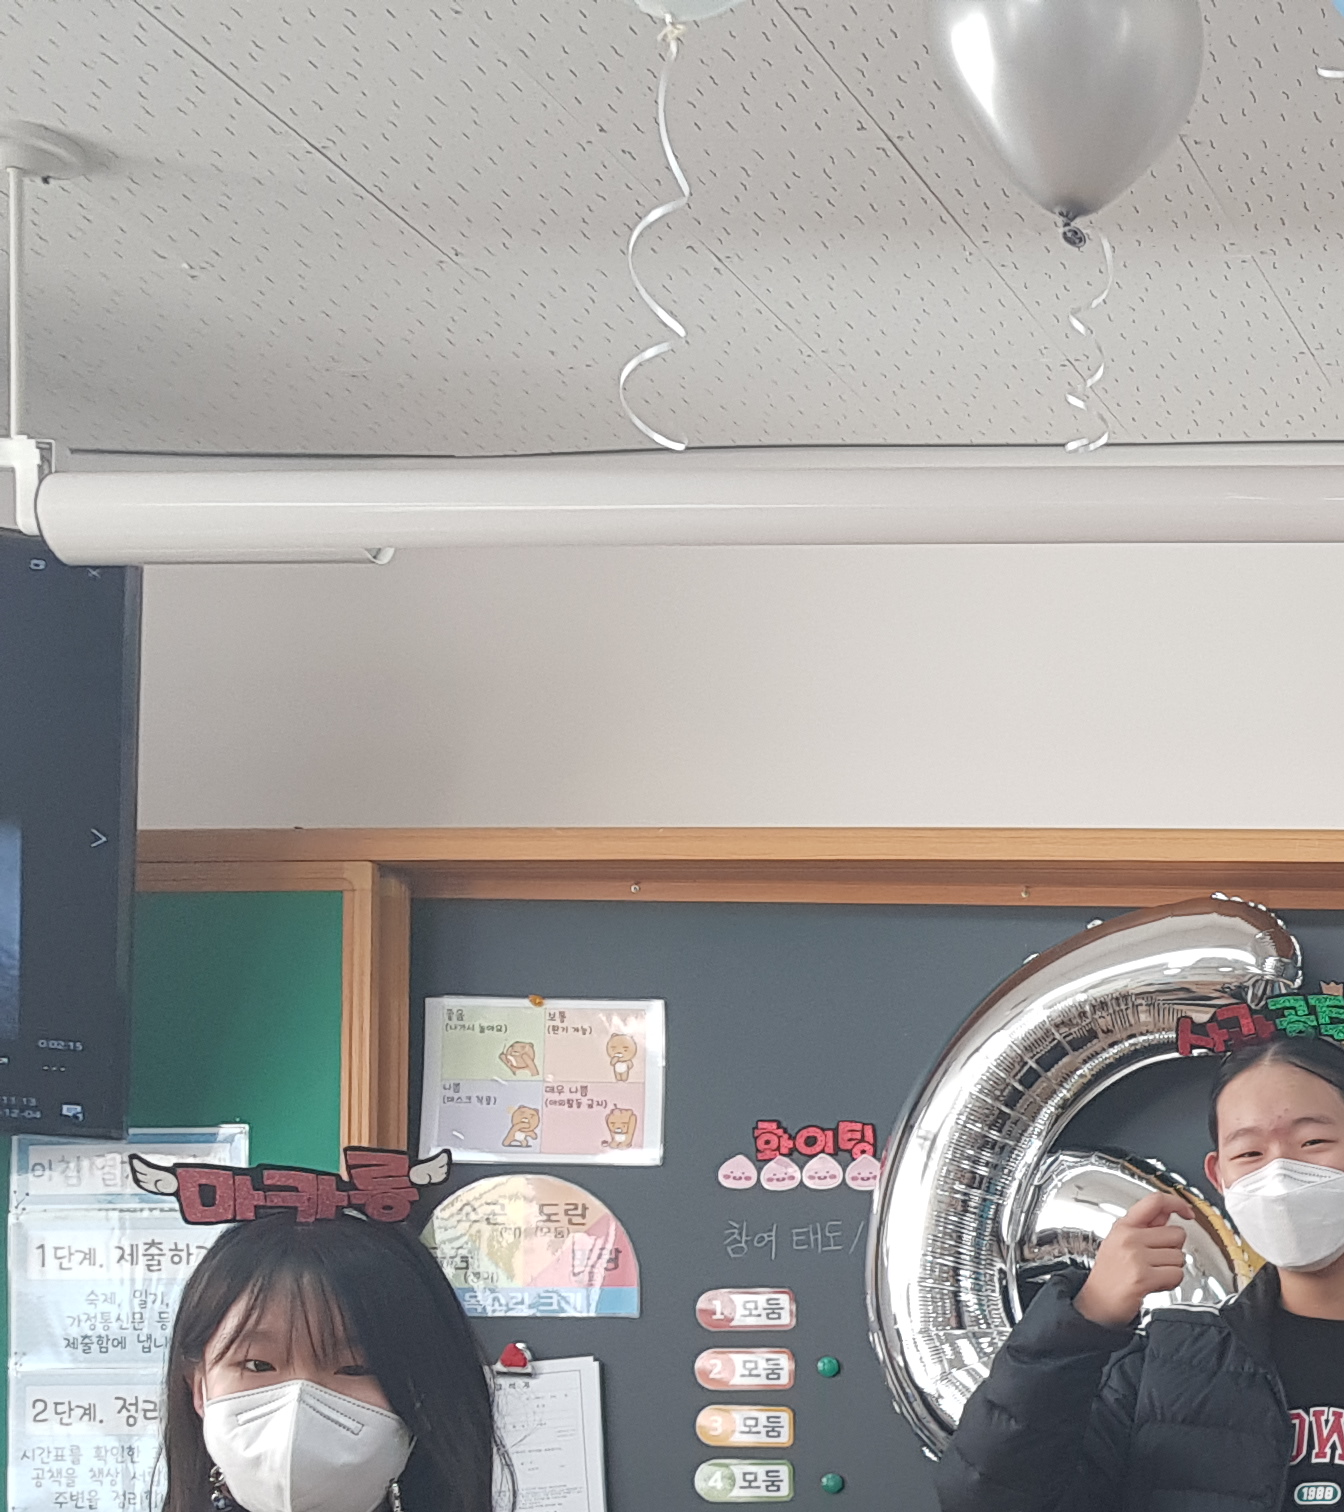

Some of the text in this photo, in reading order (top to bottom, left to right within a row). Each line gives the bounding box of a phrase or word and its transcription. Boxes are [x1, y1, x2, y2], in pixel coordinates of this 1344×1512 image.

[724, 1220, 777, 1260] 참여
[66, 1313, 145, 1331] 가정통신문
[63, 1337, 127, 1354] 제출함에
[709, 1356, 784, 1381] 2 모둠
[31, 1398, 104, 1426] 2단계.
[709, 1415, 784, 1439] 3 모둠
[708, 1469, 784, 1493] 4 모둠
